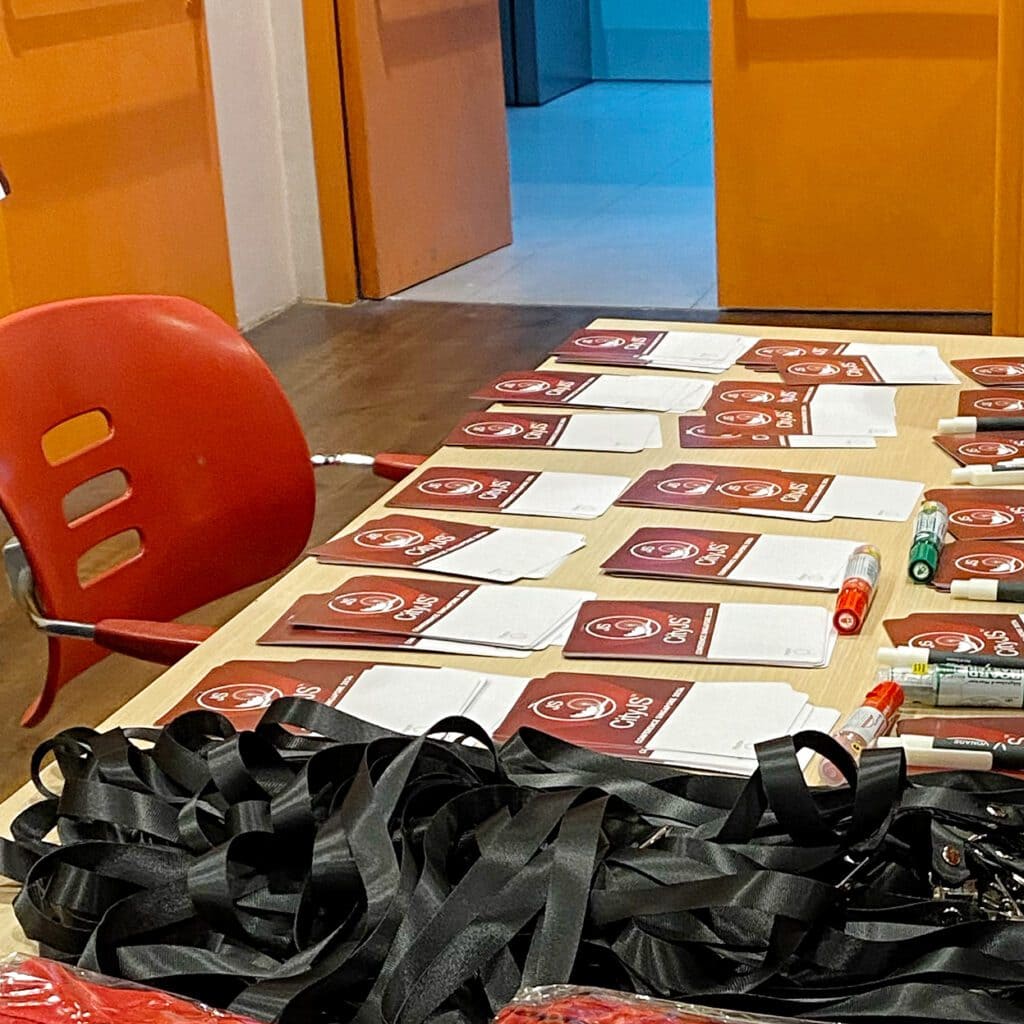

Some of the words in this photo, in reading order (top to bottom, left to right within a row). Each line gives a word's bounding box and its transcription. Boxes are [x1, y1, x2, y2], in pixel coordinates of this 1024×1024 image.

[663, 615, 694, 644] CityJS
[984, 630, 1020, 657] CityJS
[609, 694, 654, 729] CityJS
